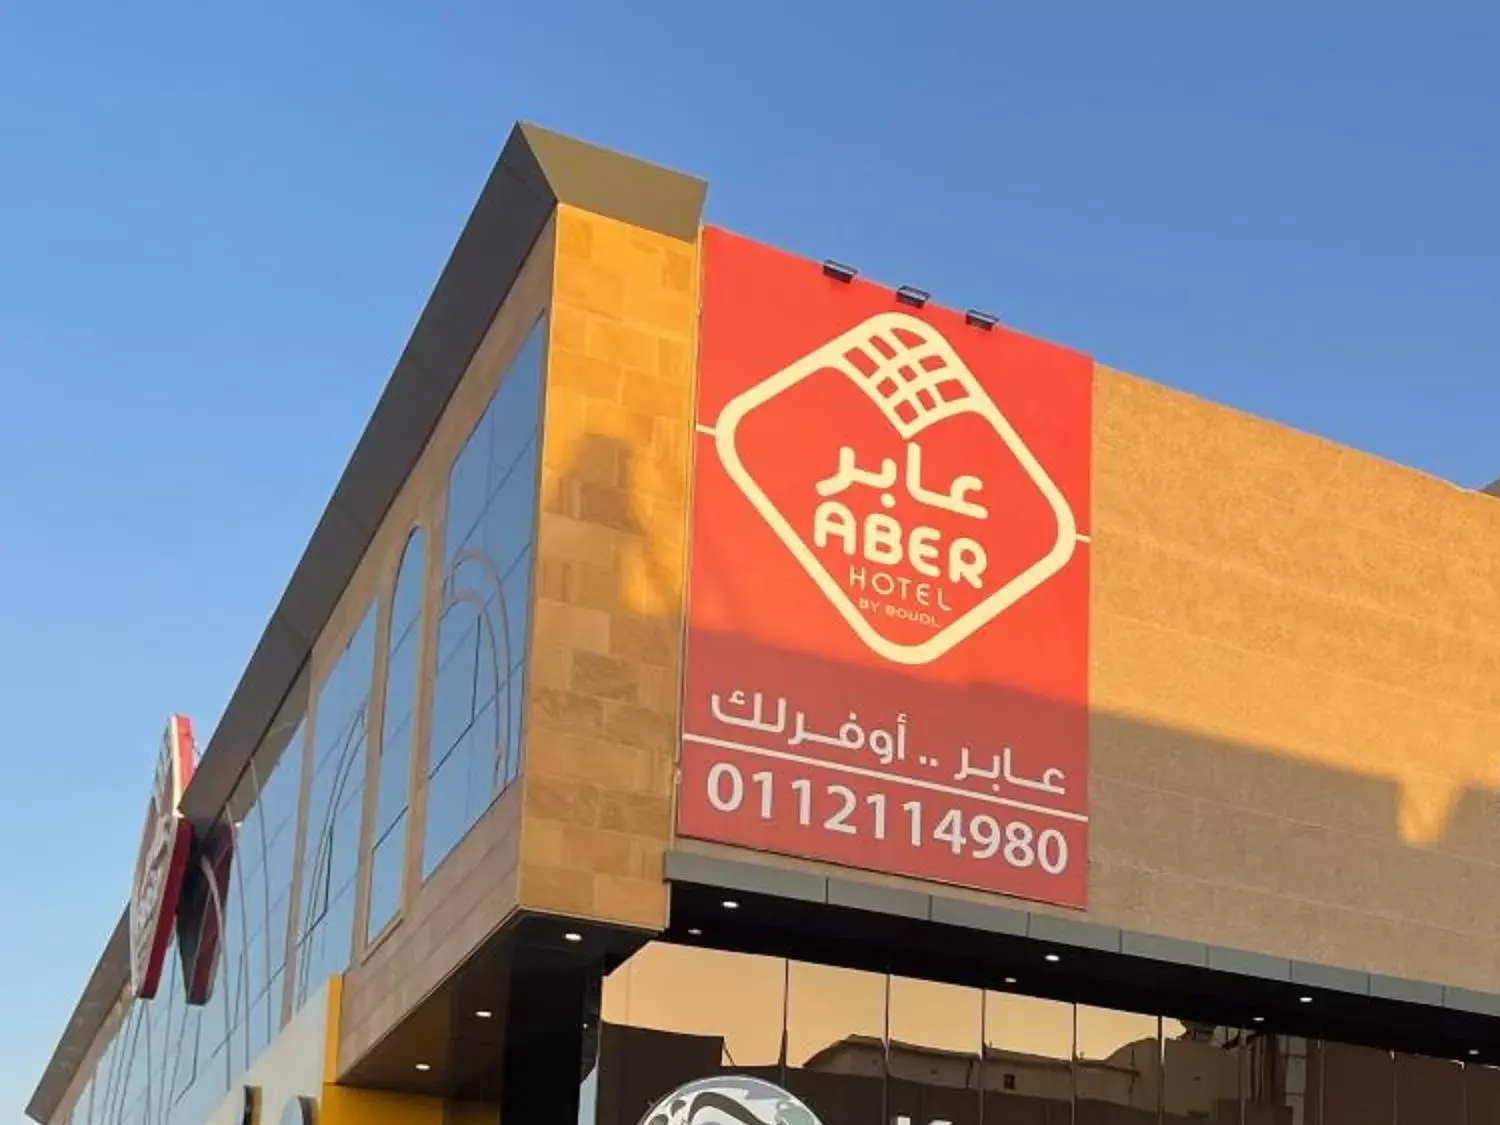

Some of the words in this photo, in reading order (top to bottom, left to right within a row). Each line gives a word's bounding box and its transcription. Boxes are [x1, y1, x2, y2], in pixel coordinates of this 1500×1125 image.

[815, 441, 989, 520] عابر
[813, 500, 988, 589] ABER
[849, 563, 953, 612] HOTEL
[859, 597, 880, 613] BY
[953, 747, 1066, 796] عابر
[706, 762, 1069, 875] 0112114980
